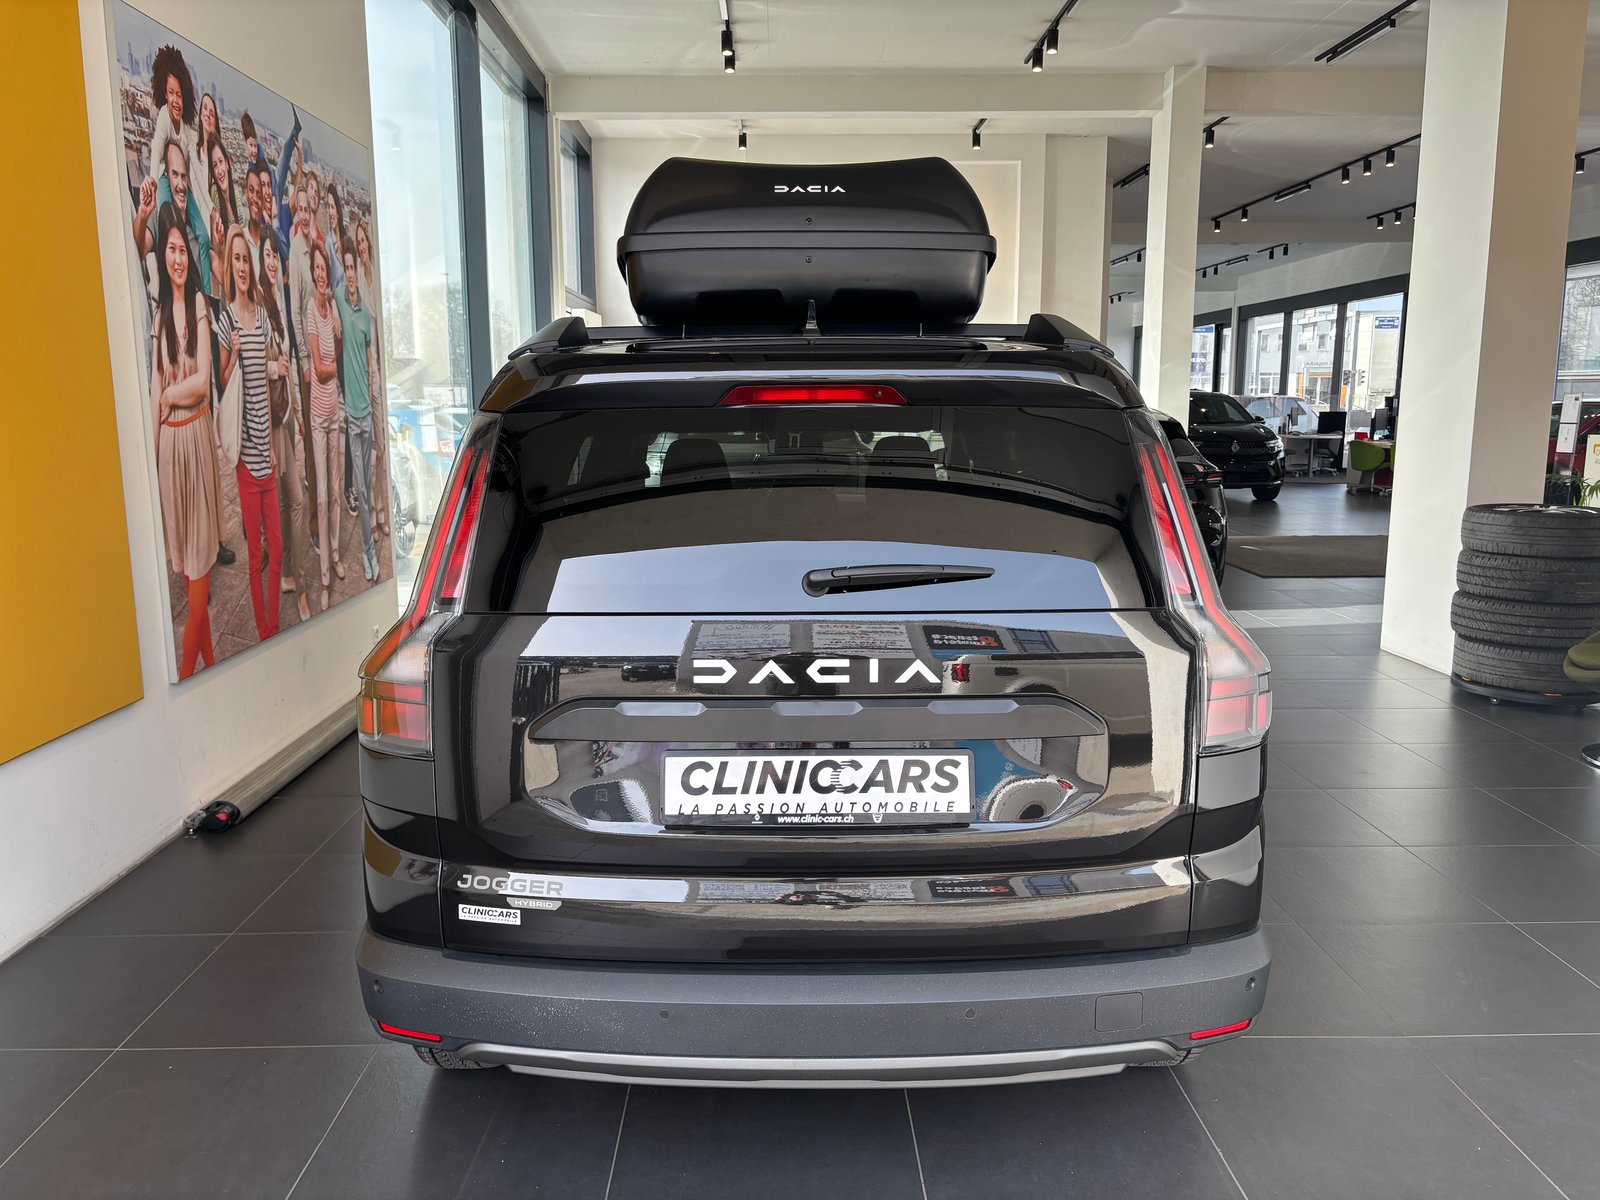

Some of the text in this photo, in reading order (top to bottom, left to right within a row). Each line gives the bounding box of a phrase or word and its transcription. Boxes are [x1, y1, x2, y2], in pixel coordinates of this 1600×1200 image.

[774, 185, 847, 193] DACIA
[693, 658, 942, 684] DACIA
[678, 801, 955, 815] LA PASSION AUTOMOBILE
[777, 814, 854, 824] www.clinic-cars.ch
[456, 874, 564, 896] JOGGER
[514, 899, 553, 908] HYBRID
